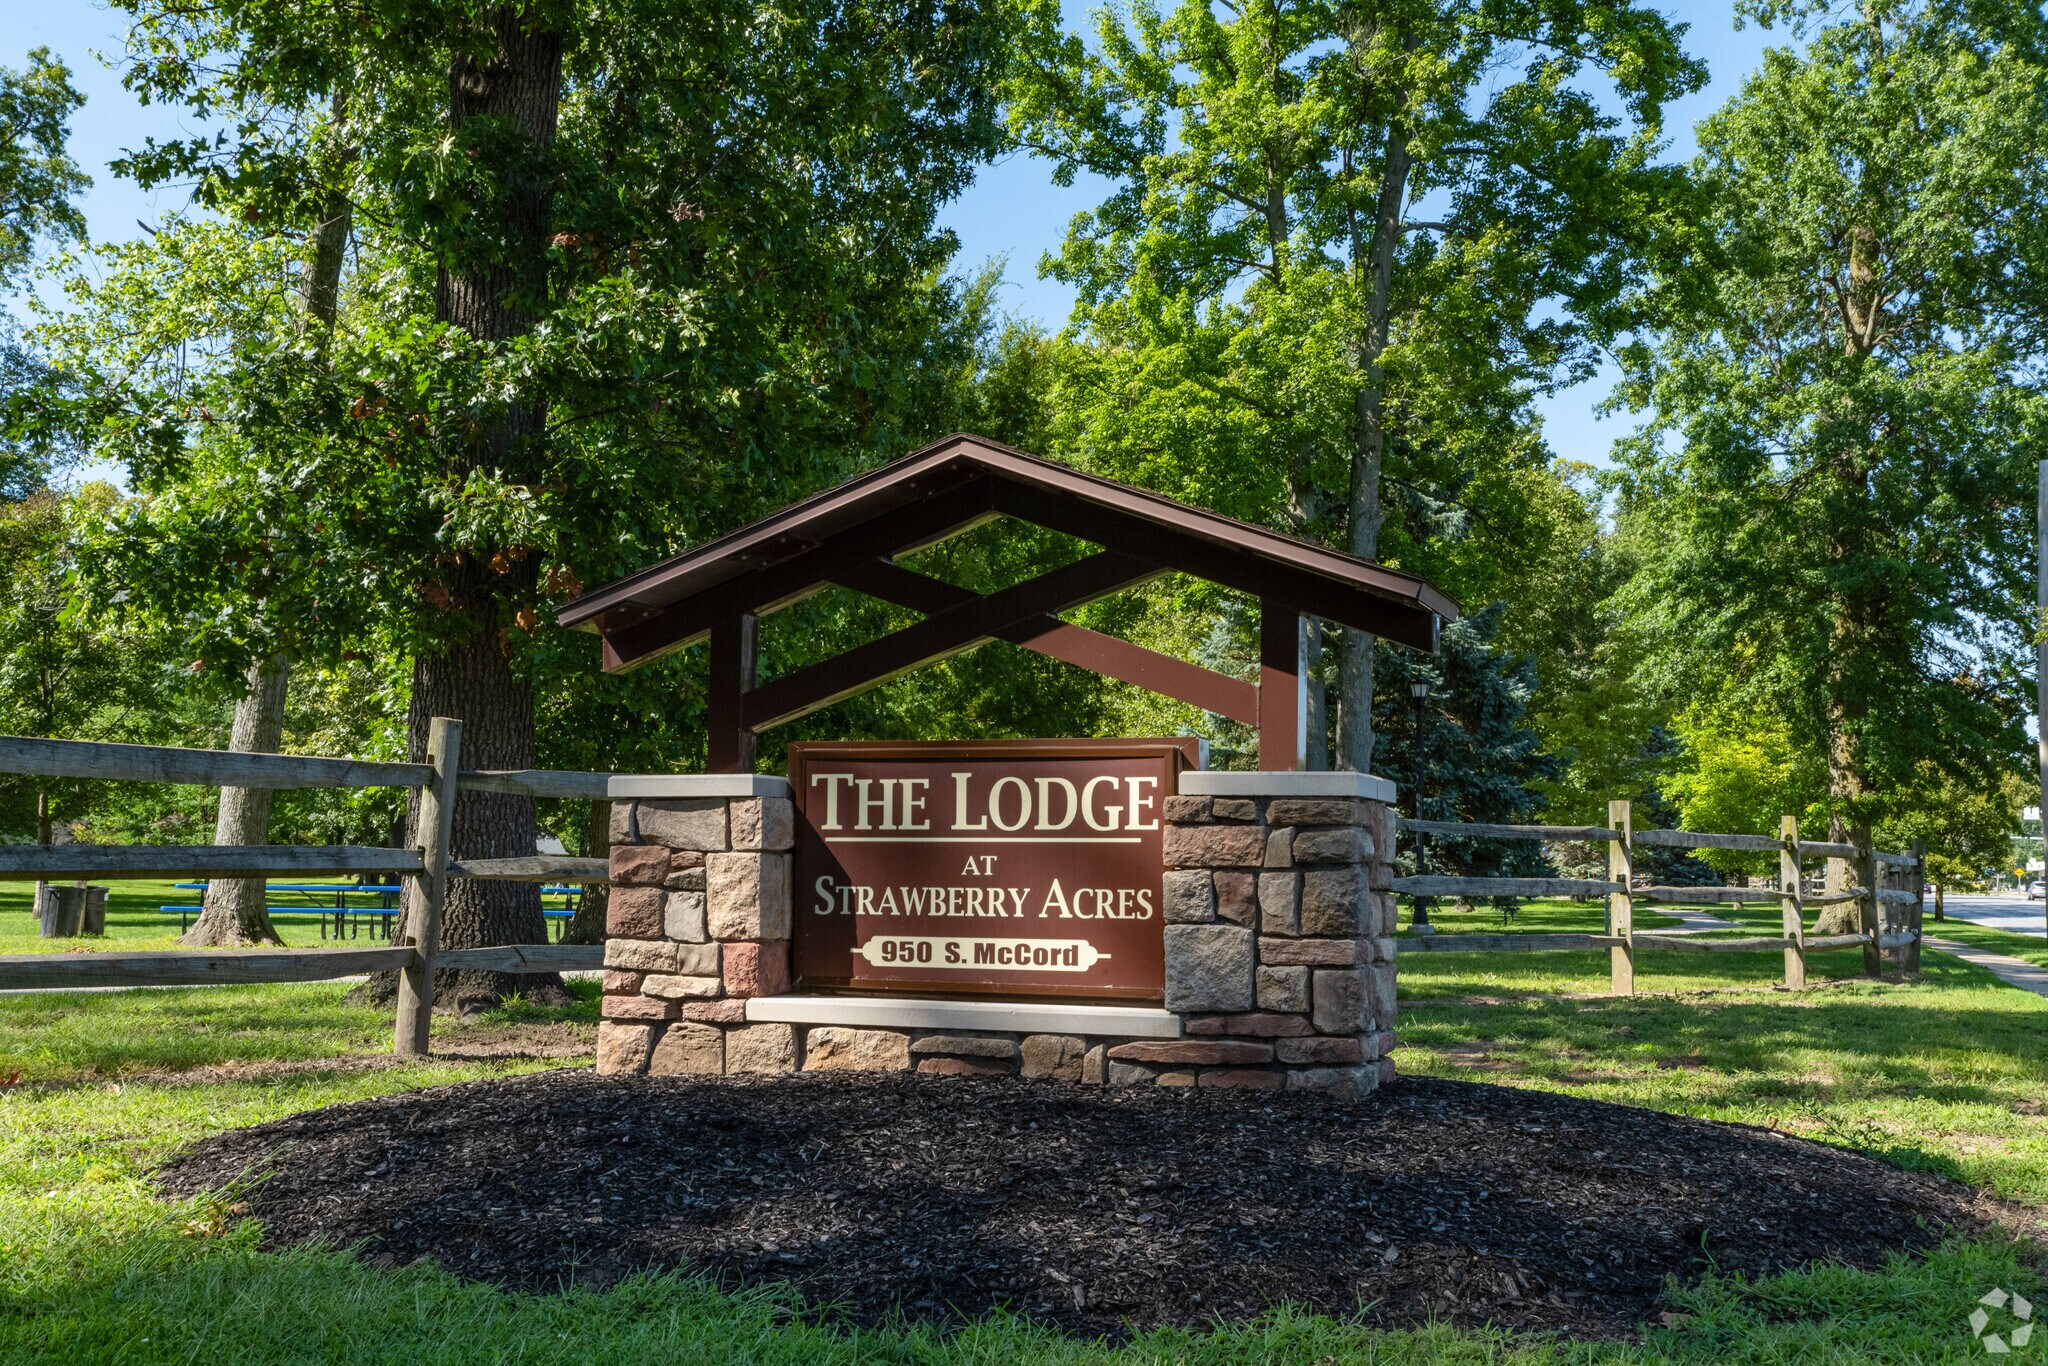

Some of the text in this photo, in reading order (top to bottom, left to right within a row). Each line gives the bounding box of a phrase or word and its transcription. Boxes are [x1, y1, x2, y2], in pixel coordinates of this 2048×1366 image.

[961, 855, 997, 876] AT
[814, 875, 1154, 920] STRAWBERRY ACRES
[881, 941, 932, 963] 950
